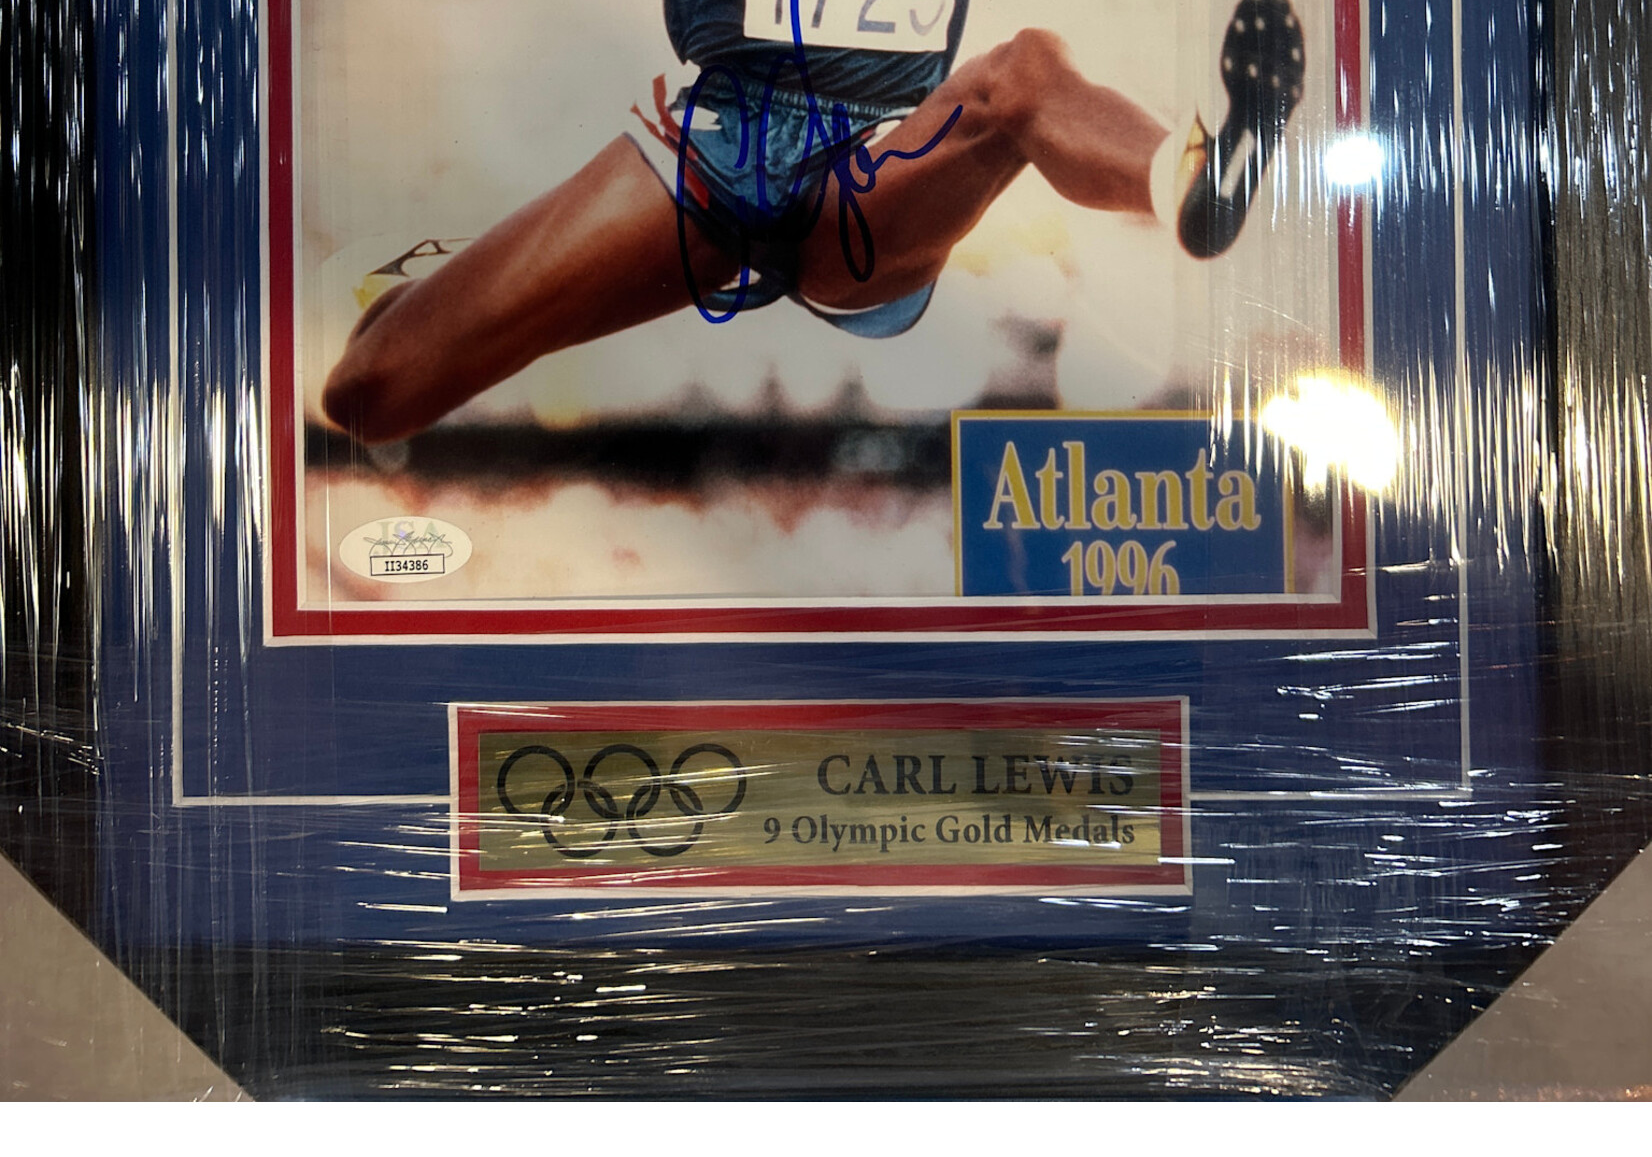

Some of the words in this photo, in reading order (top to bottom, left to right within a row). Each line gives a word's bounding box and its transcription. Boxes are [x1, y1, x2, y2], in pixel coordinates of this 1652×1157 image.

[983, 441, 1262, 531] Atlanta
[1061, 540, 1181, 596] 1996
[817, 754, 957, 795] CARL
[971, 754, 1135, 796] LEWIS
[763, 817, 781, 844] 9
[792, 814, 926, 853] Olympic
[935, 814, 1013, 844] Gold
[1023, 813, 1135, 845] Medals
